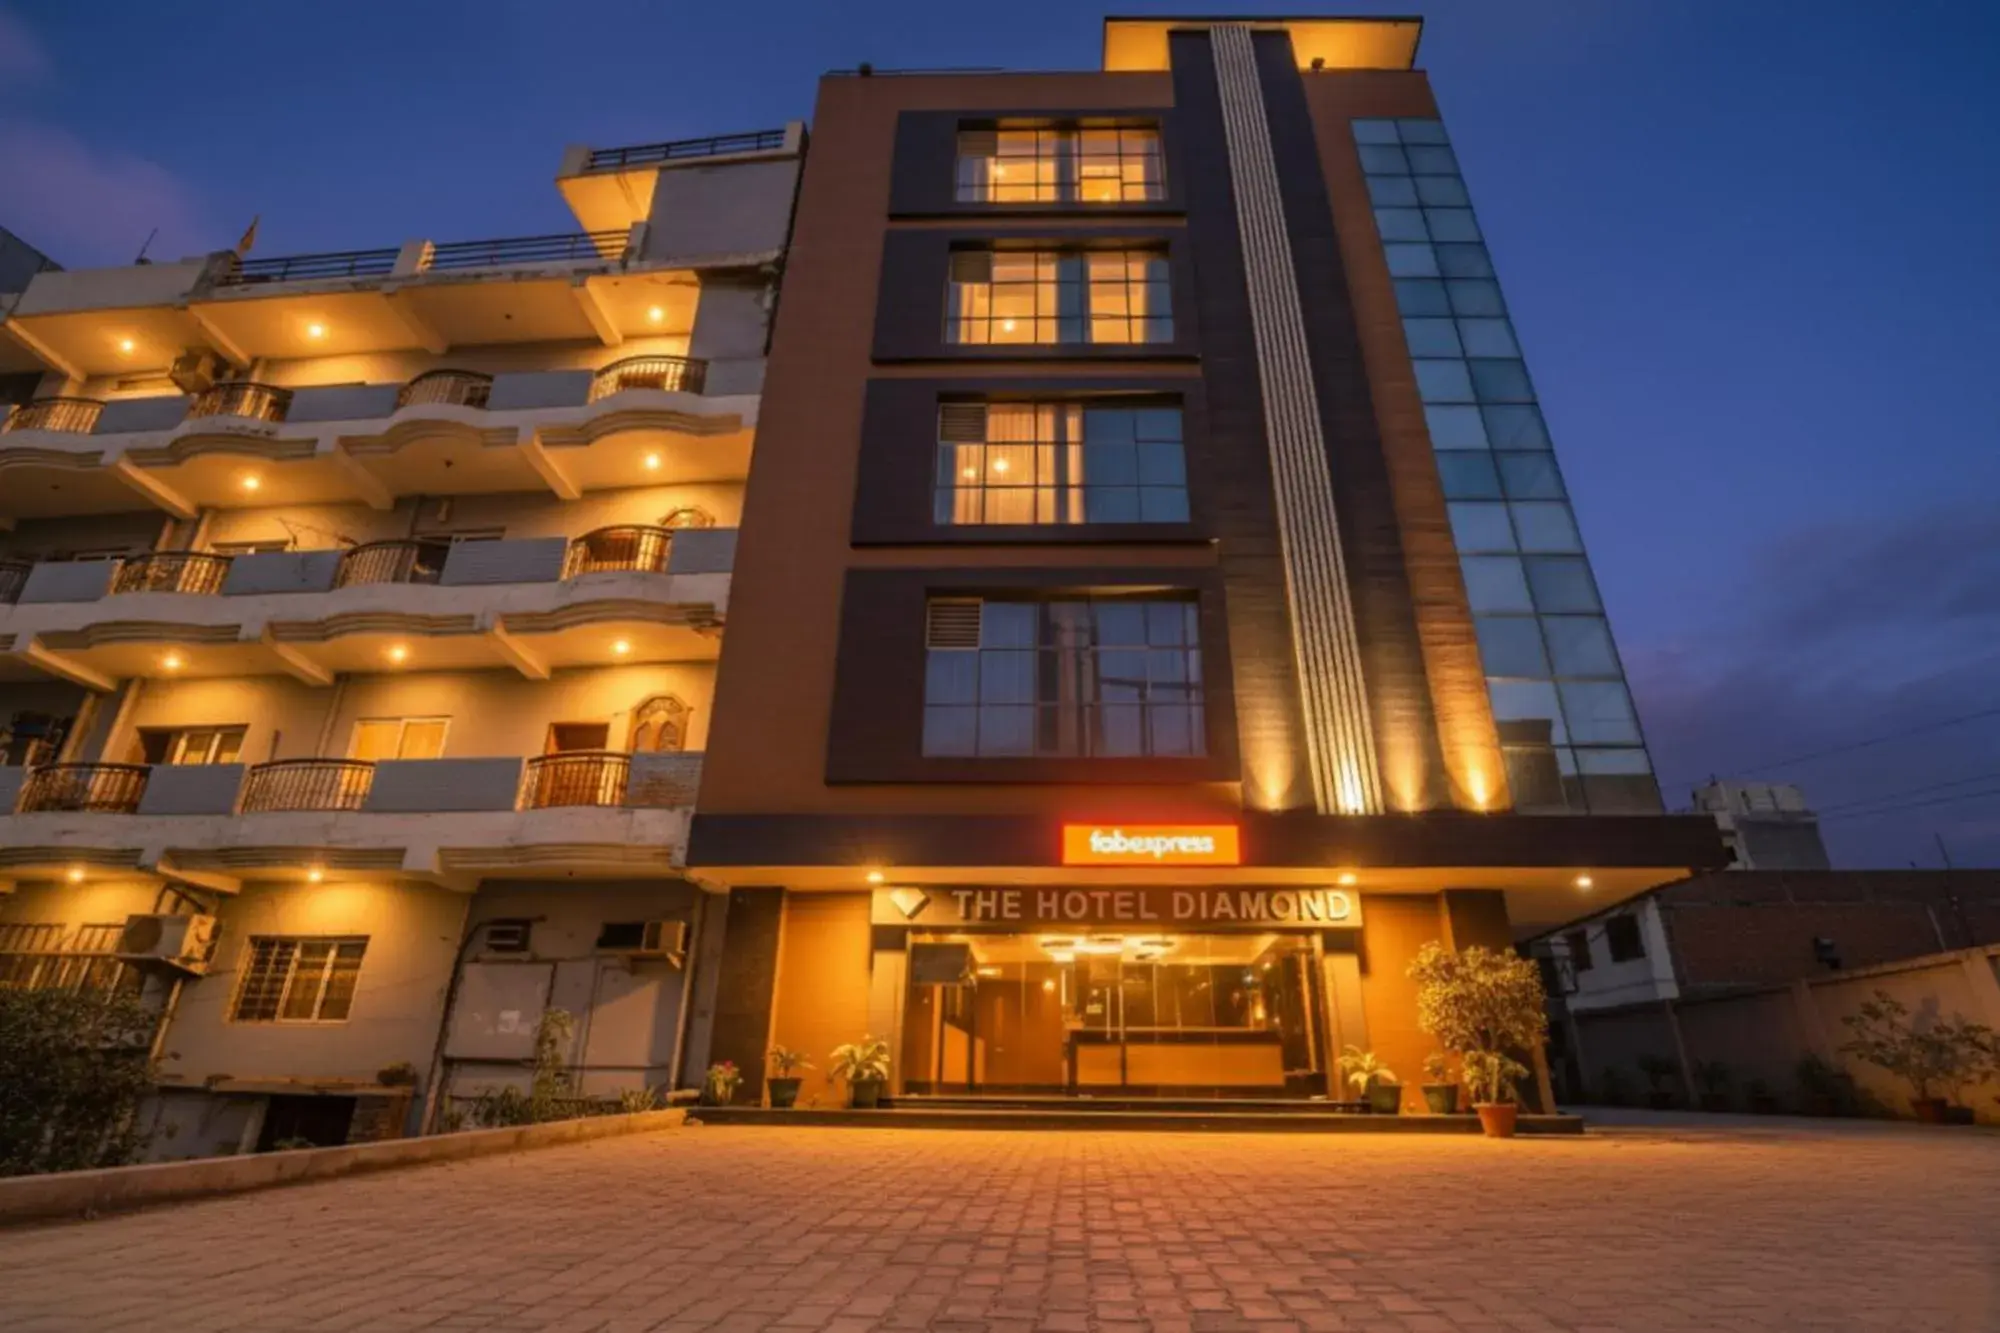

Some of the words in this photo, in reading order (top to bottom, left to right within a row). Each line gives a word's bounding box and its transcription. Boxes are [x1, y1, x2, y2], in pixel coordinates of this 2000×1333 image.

[951, 890, 1021, 919] THE
[1037, 890, 1159, 920] HOTEL
[1172, 890, 1351, 920] DIAMOND
